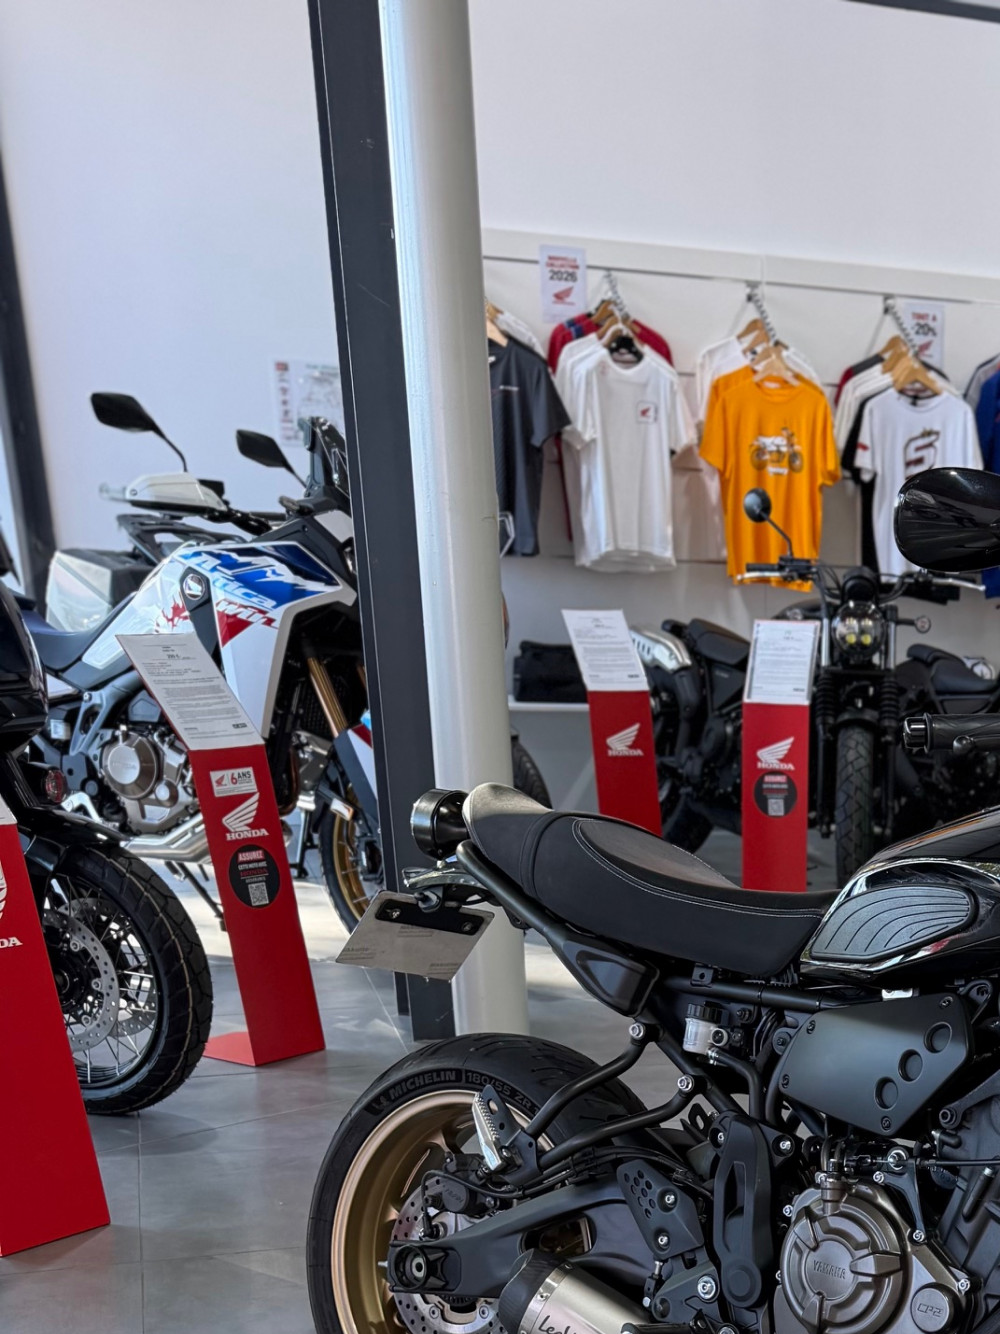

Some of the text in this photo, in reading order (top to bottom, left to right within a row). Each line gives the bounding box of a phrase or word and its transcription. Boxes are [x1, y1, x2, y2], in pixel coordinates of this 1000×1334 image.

[549, 269, 577, 282] 2026
[607, 749, 644, 757] HONDA
[757, 761, 795, 771] HONDA
[230, 772, 238, 785] 6
[237, 771, 251, 779] ANS
[225, 828, 270, 841] HONDA
[390, 1070, 456, 1099] MICHELIN
[515, 1093, 534, 1110] ZR
[813, 1260, 847, 1279] YAMAHA
